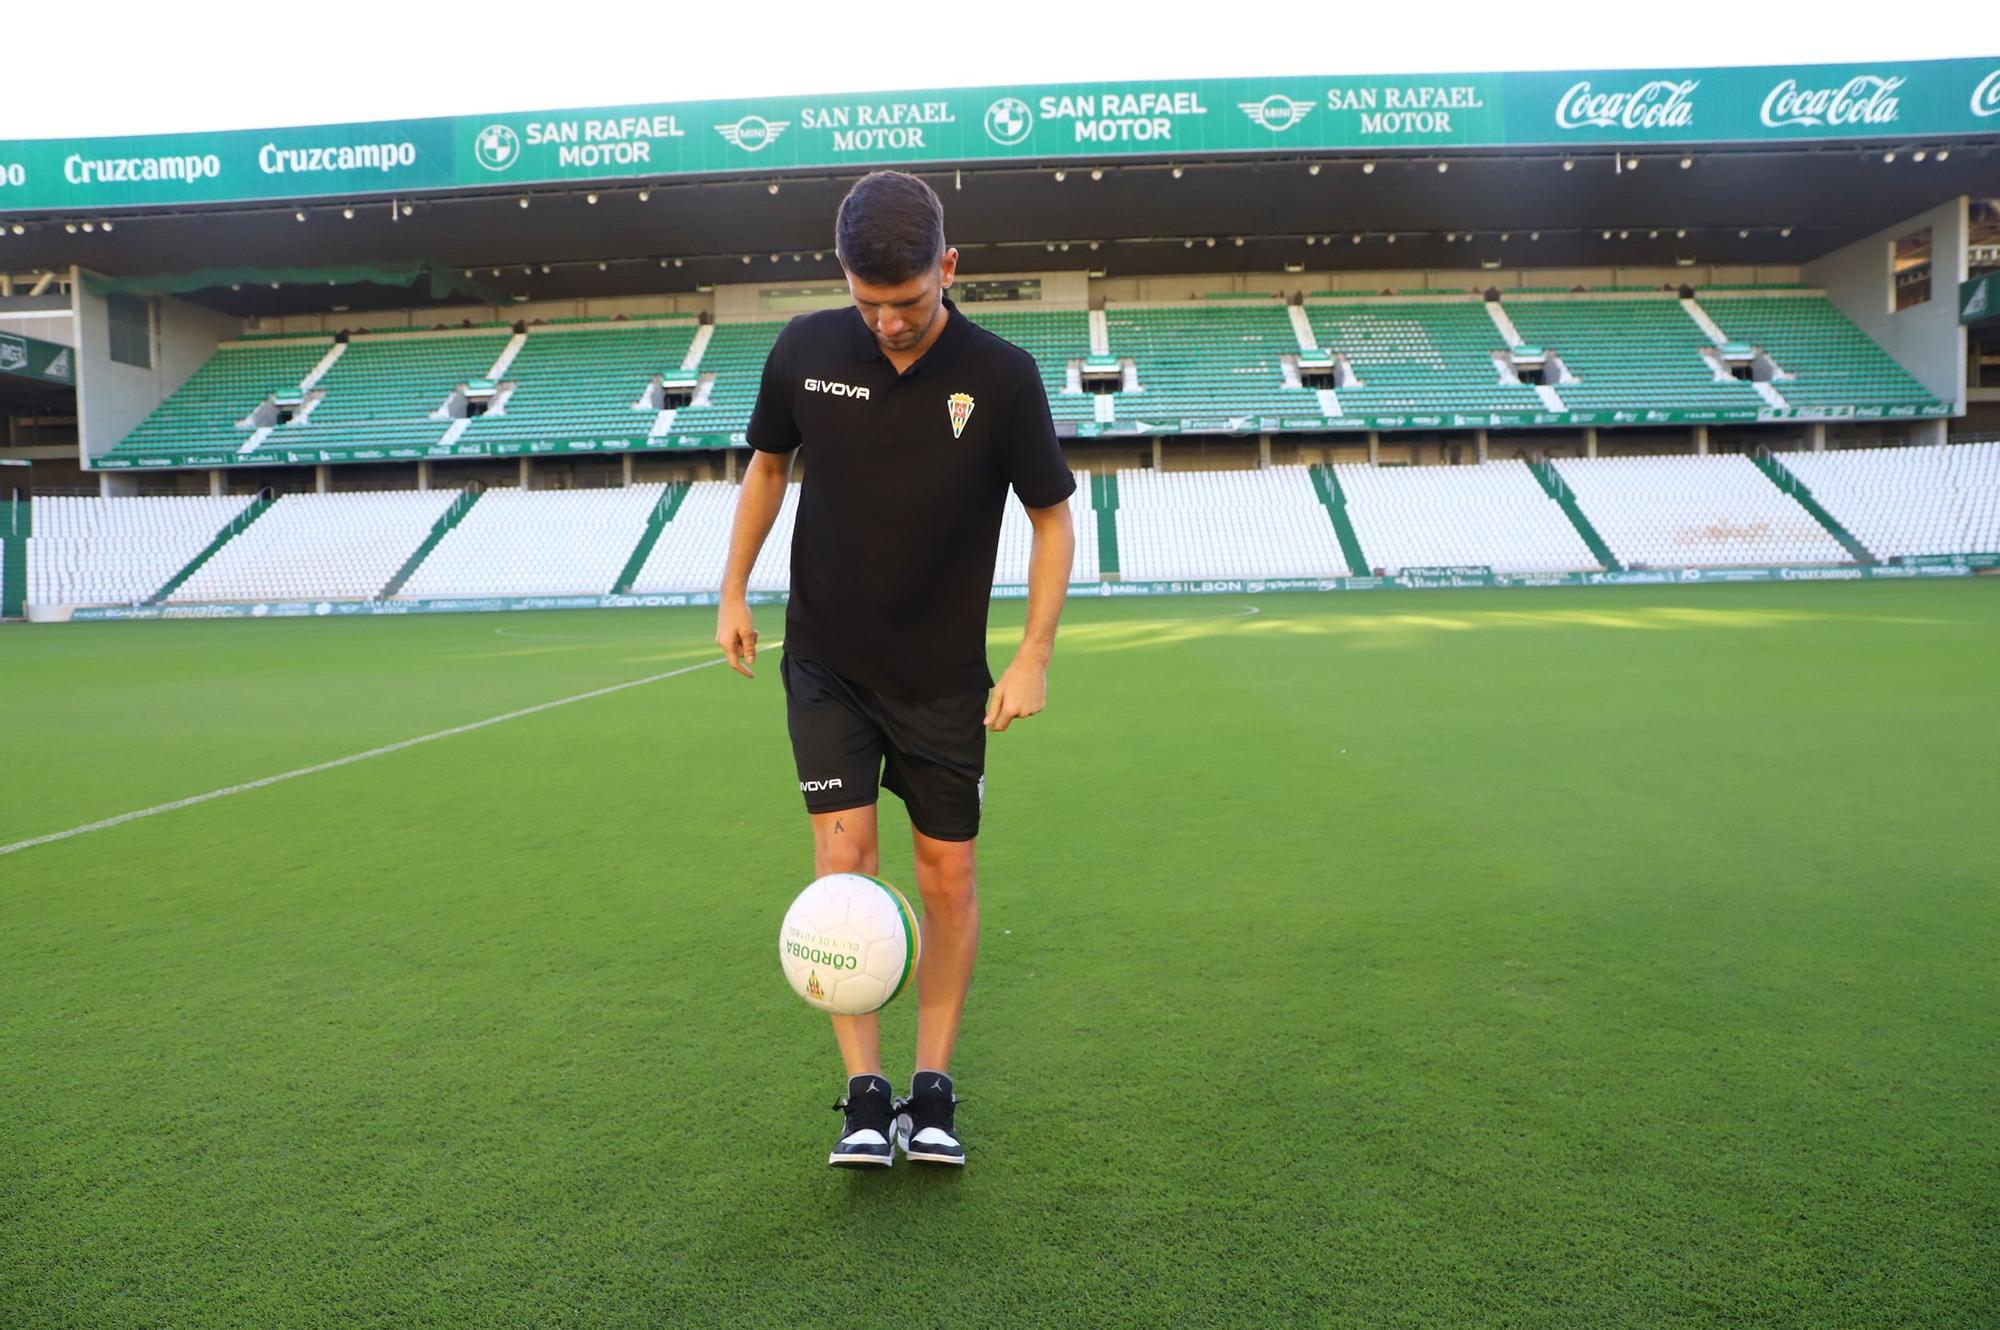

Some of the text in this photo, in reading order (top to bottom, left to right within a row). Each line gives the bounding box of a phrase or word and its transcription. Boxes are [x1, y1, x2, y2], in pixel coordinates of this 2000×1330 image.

[1039, 92, 1208, 119] SAN RAFAEL
[1327, 86, 1483, 110] SAN RAFAEL
[1555, 78, 1702, 129] Coca-Cola
[1760, 73, 1908, 128] Coca-Cola
[801, 102, 956, 129] SAN RAFAEL
[1264, 107, 1292, 118] MINI
[1360, 111, 1452, 134] MOTOR
[526, 115, 685, 145] SAN RAFAEL
[739, 128, 766, 140] MINI
[832, 127, 926, 152] MOTOR
[1074, 118, 1172, 142] MOTOR
[258, 142, 417, 175] Cruzcampo
[559, 141, 650, 167] MOTOR
[64, 153, 221, 185] Cruzcampo
[804, 378, 871, 401] GIVOVA
[1170, 581, 1242, 593] SILBON
[615, 596, 687, 607] GIVOVA
